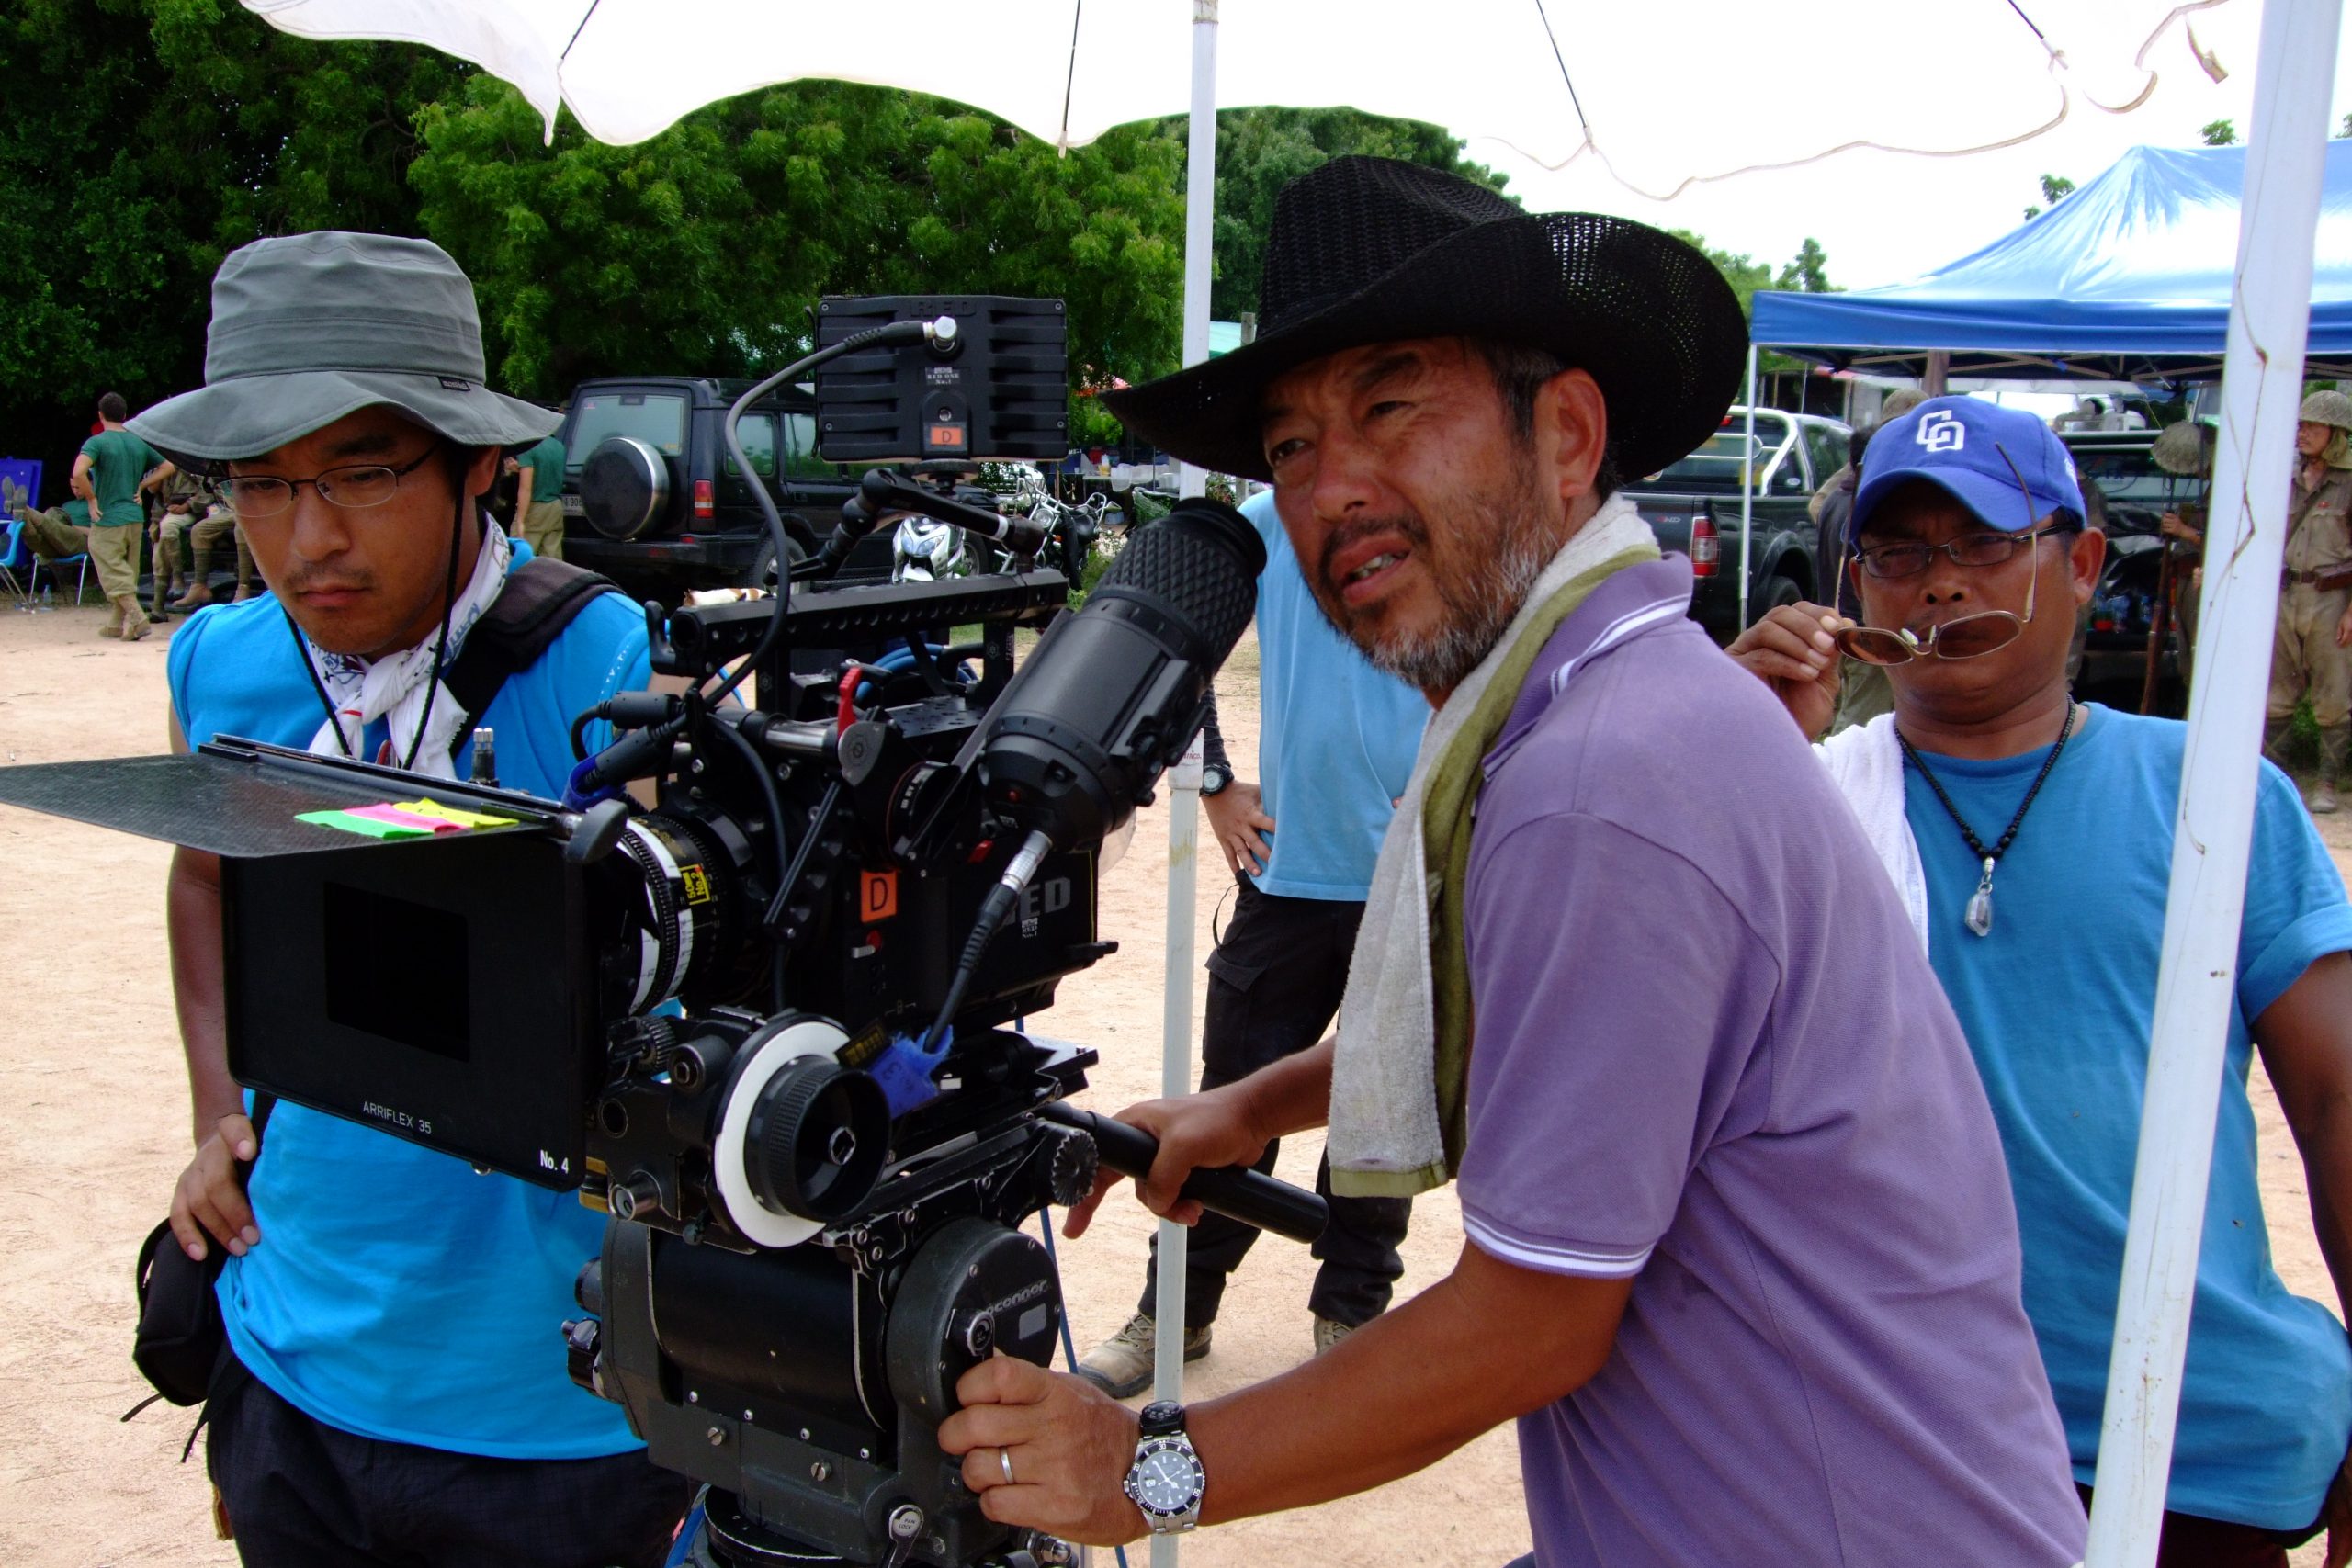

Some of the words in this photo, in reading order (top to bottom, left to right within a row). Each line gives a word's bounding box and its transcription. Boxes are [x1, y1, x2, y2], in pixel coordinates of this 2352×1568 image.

[942, 430, 952, 443] D
[869, 877, 888, 911] D
[1003, 877, 1071, 926] ED
[363, 1100, 413, 1129] ARRIFLEX
[418, 1119, 433, 1135] 35
